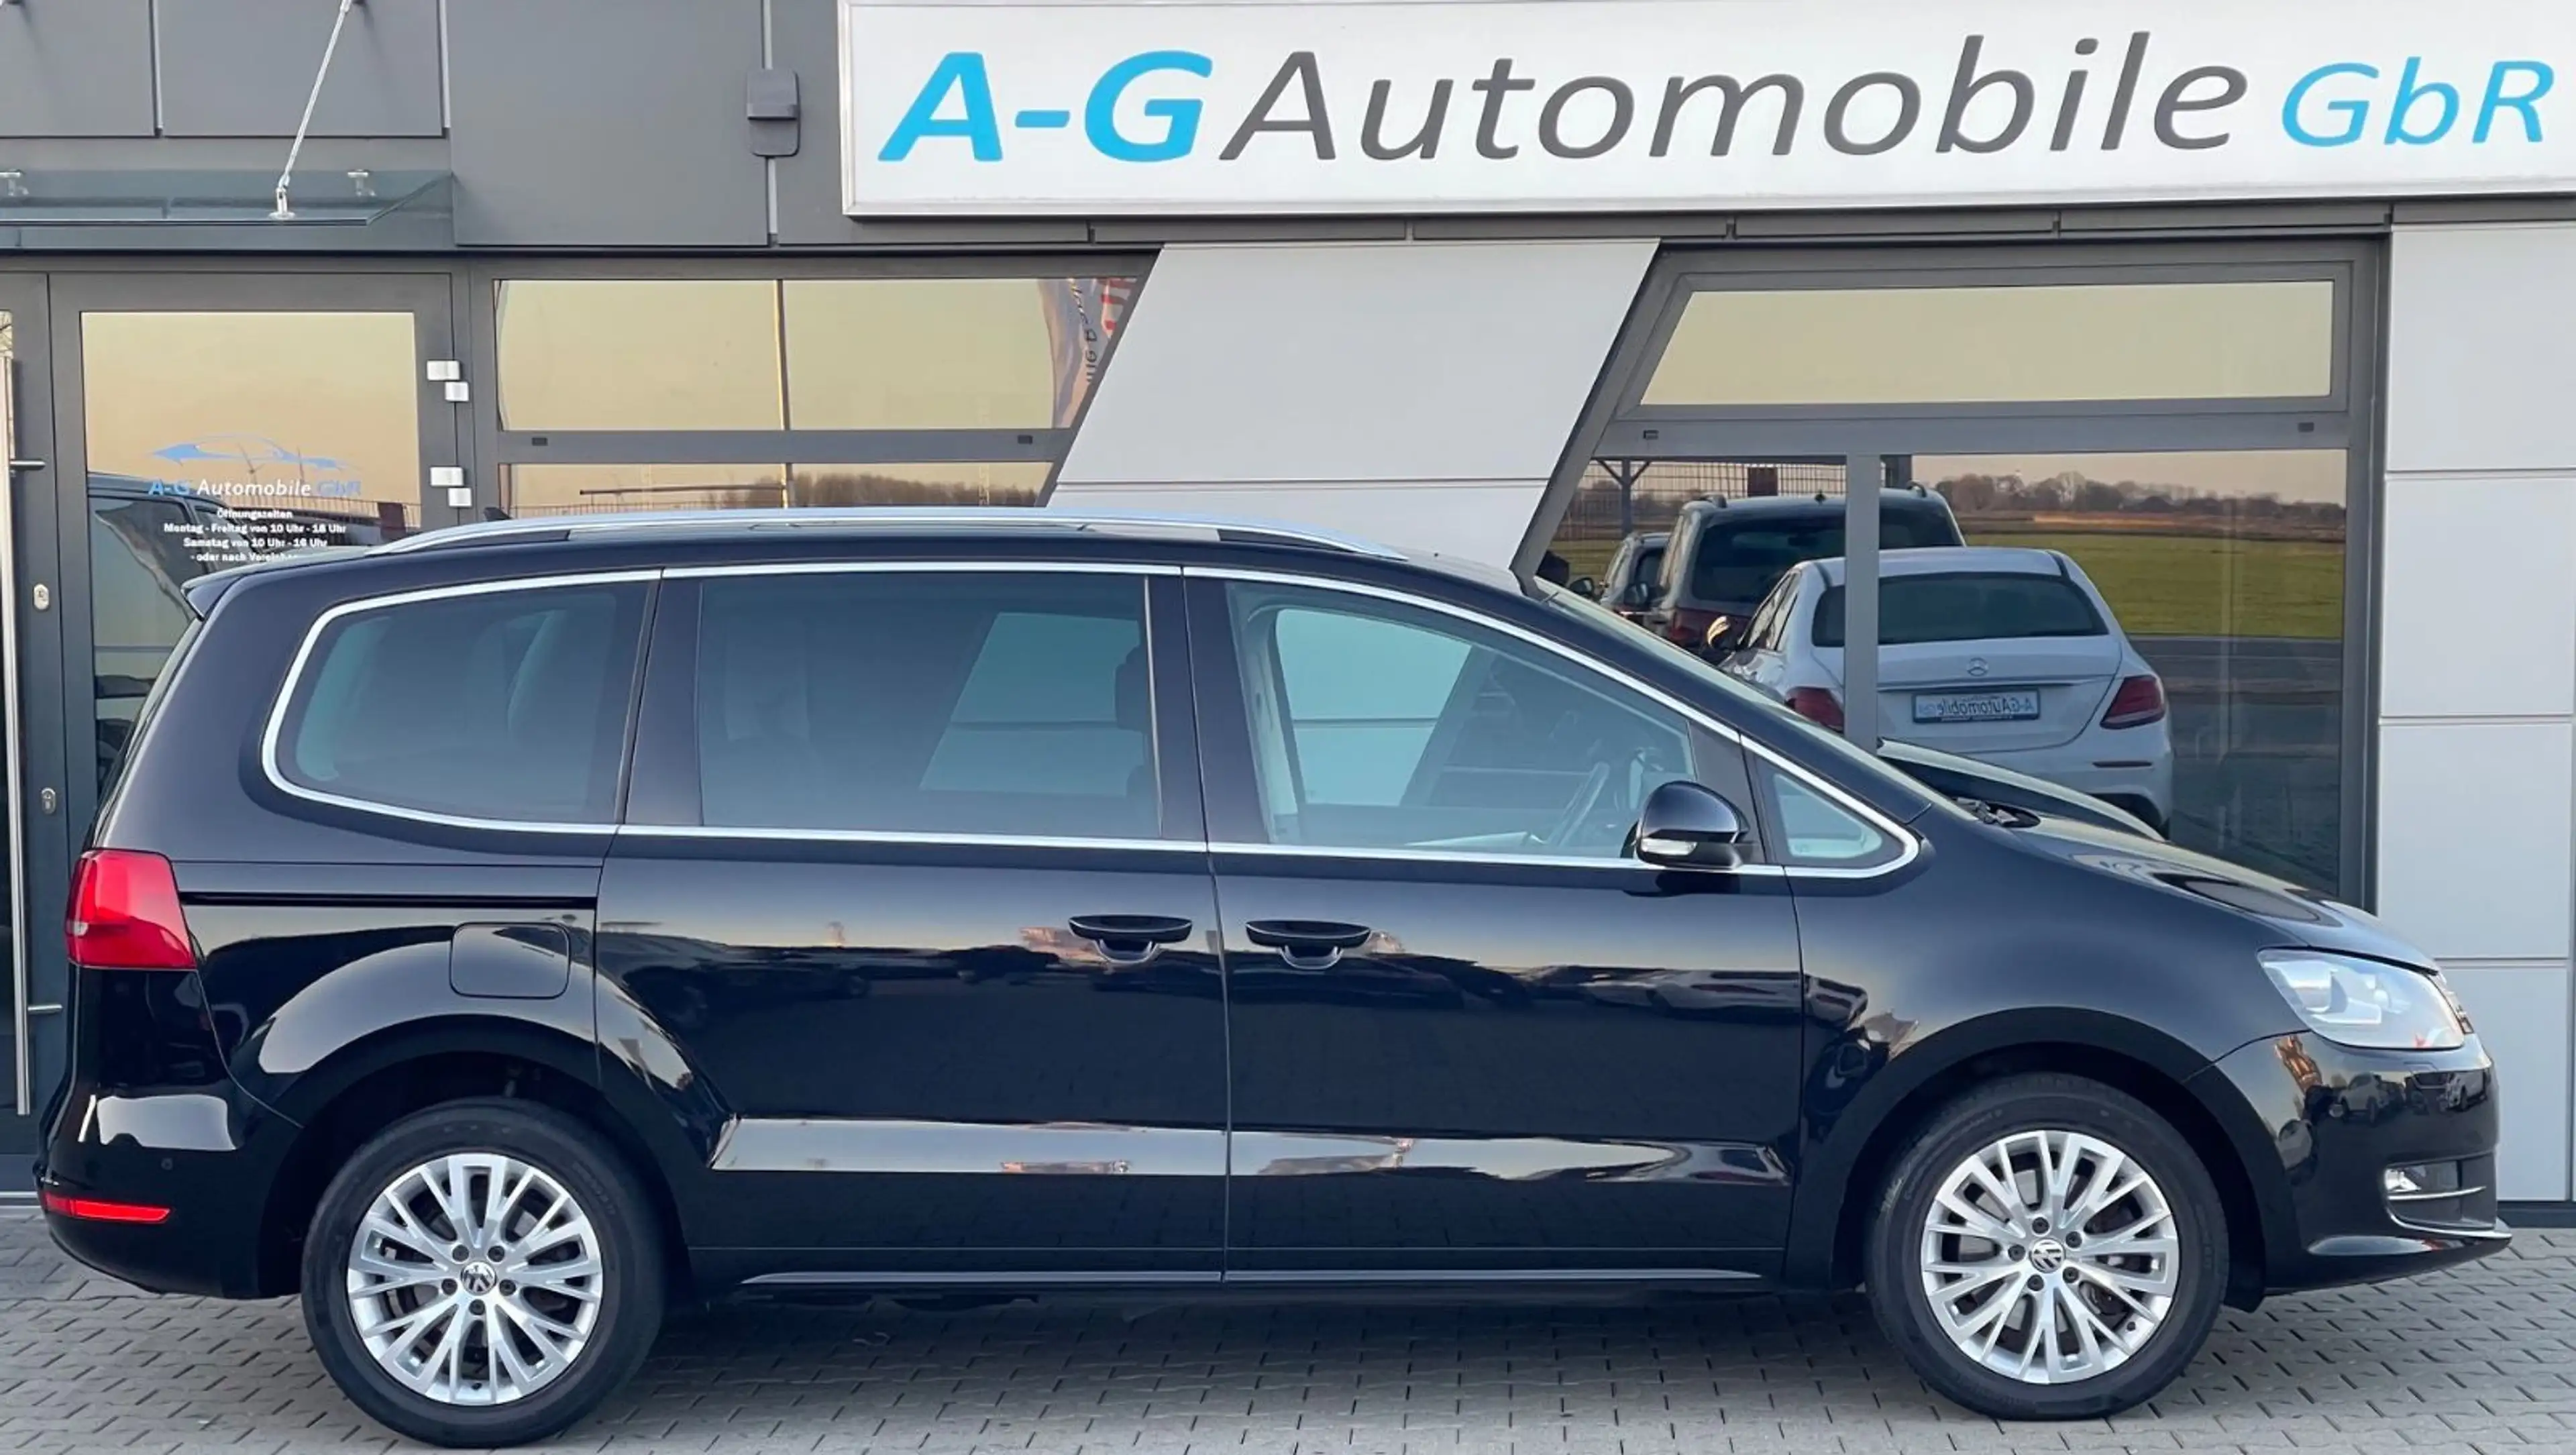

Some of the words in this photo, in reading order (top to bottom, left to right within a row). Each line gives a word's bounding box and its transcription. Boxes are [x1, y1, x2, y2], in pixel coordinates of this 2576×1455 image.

[878, 51, 1213, 162] A-G
[1218, 31, 2247, 162] Automobile
[2282, 56, 2555, 147] GbR
[148, 480, 189, 495] A-G
[197, 478, 311, 496] Automobile
[217, 507, 293, 521] Öffnungszeiten
[164, 523, 203, 534] Montag
[211, 523, 248, 535] Freitag
[270, 524, 284, 533] 10
[286, 524, 305, 533] Uhr
[328, 524, 347, 533] Uhr
[183, 537, 229, 549] Samstag
[251, 537, 266, 547] 10
[267, 537, 285, 547] Uhr
[309, 537, 328, 547] Uhr
[196, 553, 220, 561] oder
[222, 553, 246, 561] nach
